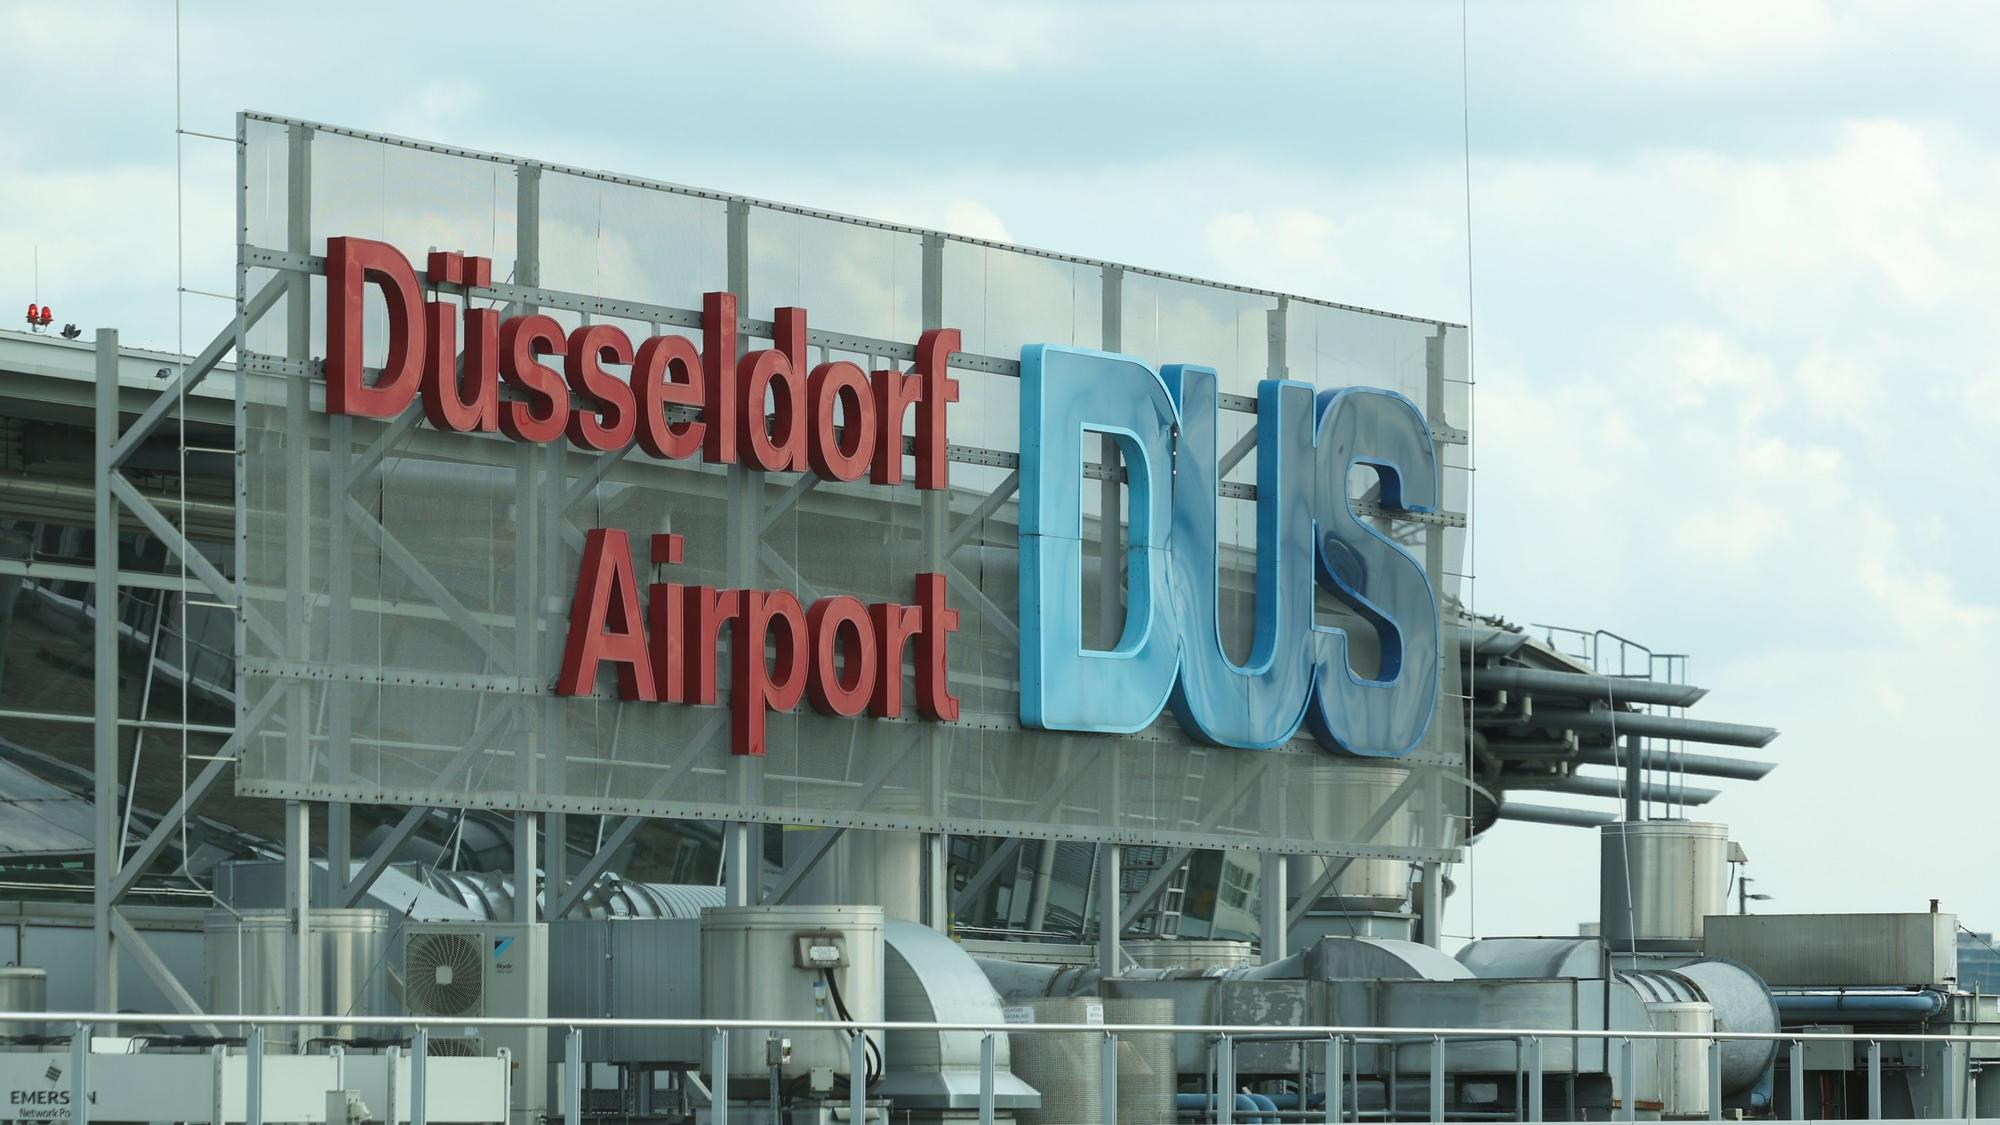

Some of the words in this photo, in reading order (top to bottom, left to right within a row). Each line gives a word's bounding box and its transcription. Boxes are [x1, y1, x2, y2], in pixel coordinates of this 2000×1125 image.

[326, 236, 961, 491] Düsseldorf
[557, 528, 960, 756] Airport
[1019, 343, 1439, 758] DUS
[10, 1090, 96, 1105] EMERSN
